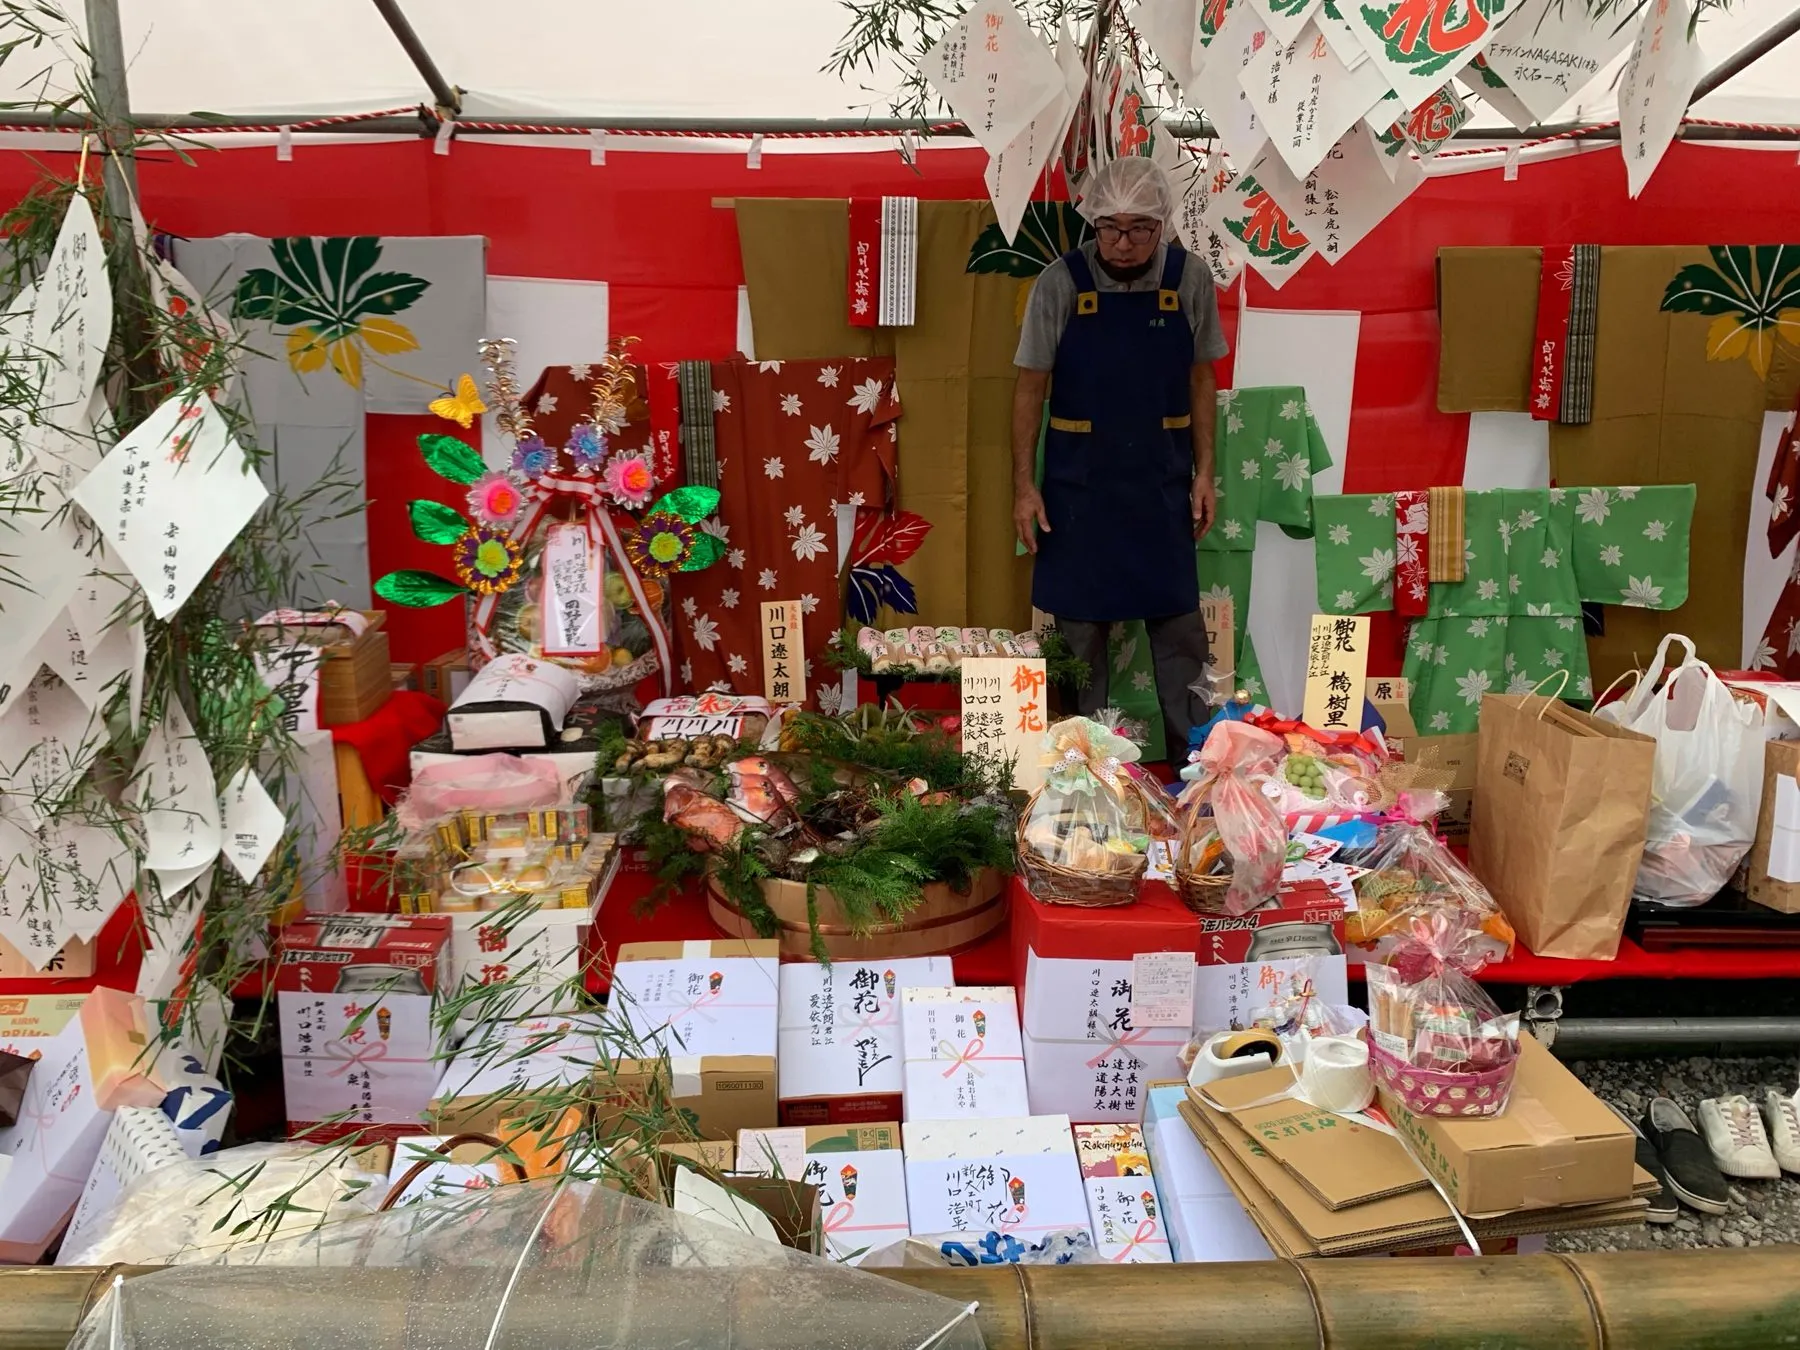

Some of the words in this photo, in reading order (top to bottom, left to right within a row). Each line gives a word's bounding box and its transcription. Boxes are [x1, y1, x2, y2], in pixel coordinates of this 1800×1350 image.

[985, 12, 1004, 52] 御花
[768, 605, 791, 699] 川口遼太朗
[1332, 617, 1357, 654] 御花
[1010, 664, 1046, 734] 御花
[849, 967, 881, 1015] 御花
